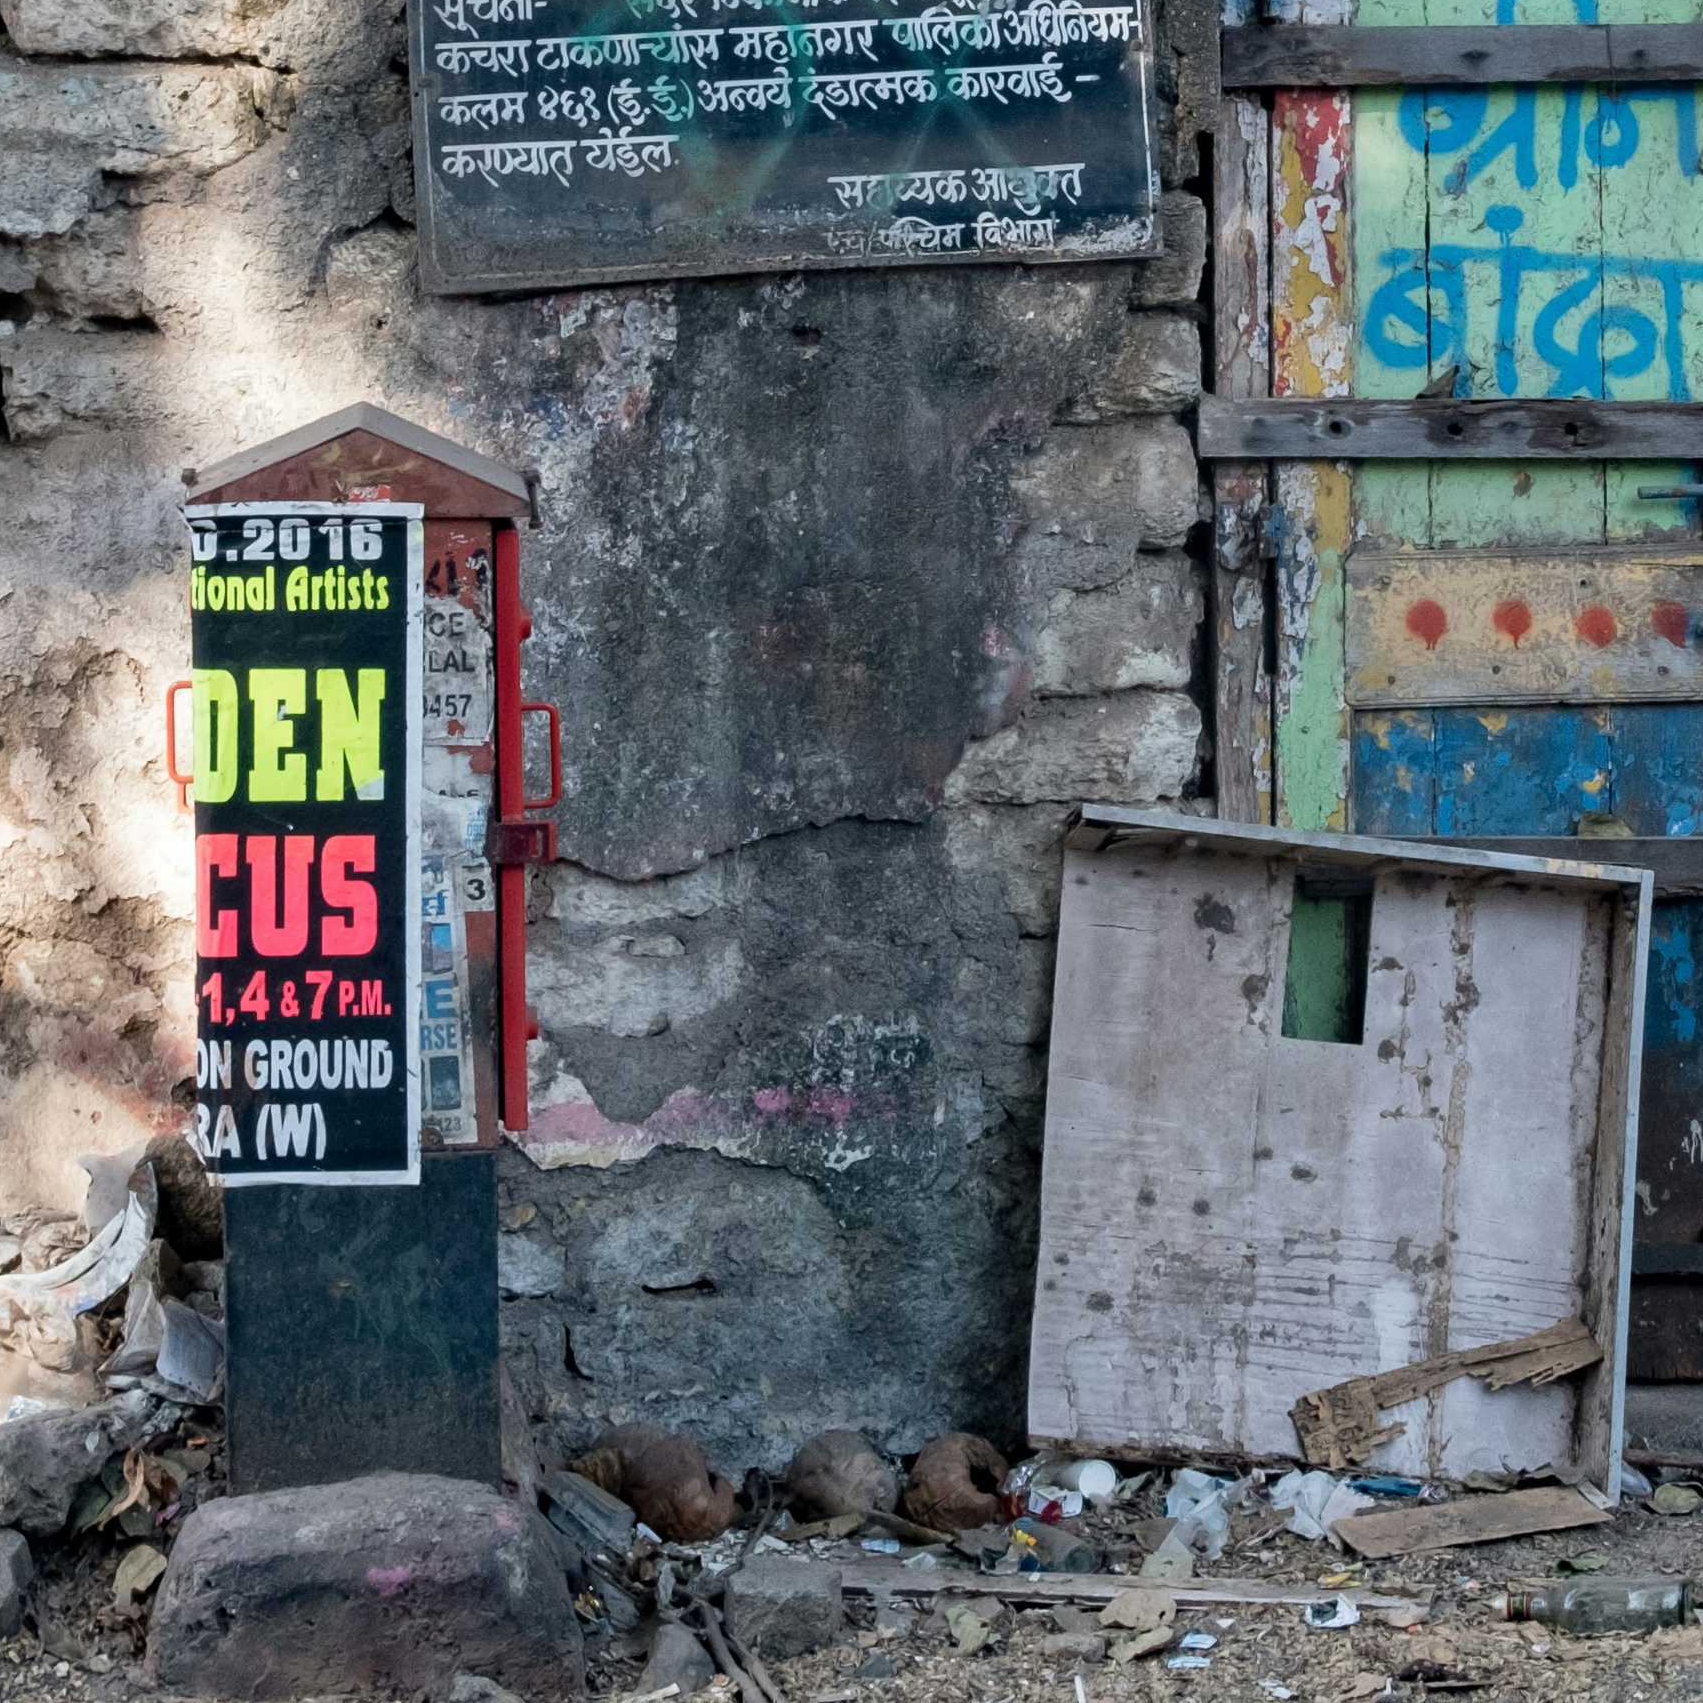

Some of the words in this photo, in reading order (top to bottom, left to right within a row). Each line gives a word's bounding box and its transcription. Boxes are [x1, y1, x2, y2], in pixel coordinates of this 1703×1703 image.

[435, 39, 532, 77] कचरा
[729, 19, 879, 64] महानगर
[883, 6, 1002, 55] पालिका
[438, 91, 528, 131] कलम
[697, 66, 793, 113] अन्वये
[798, 67, 937, 120] दंडात्मक
[945, 51, 1072, 106] कारवाई
[441, 140, 577, 189] करण्यात
[285, 564, 390, 612] Artists
[280, 979, 301, 1019] &
[305, 970, 334, 1021] 7
[338, 979, 393, 1017] P.M.
[244, 1038, 394, 1091] GROUND
[255, 1101, 328, 1162] (W)
